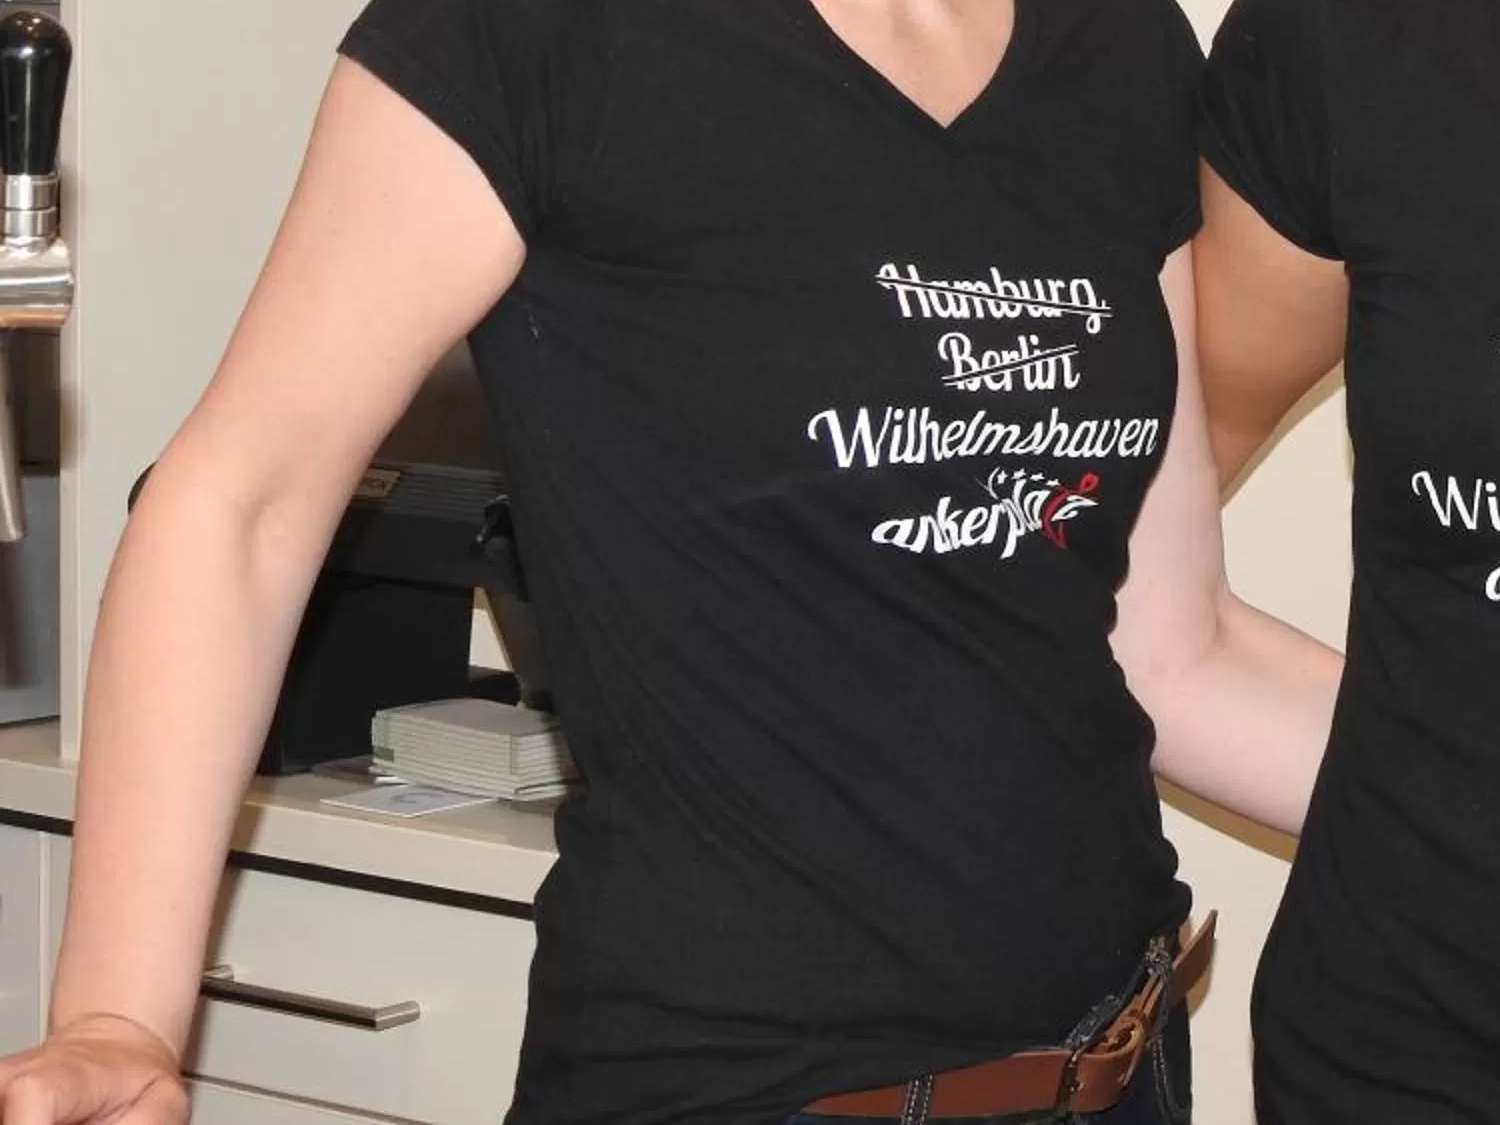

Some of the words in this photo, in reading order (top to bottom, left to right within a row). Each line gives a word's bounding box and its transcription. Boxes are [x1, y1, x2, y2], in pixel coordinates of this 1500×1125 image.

[876, 262, 1112, 334] Hamburg
[937, 331, 1080, 392] Berlin
[808, 405, 1160, 468] Wilhelmshaven
